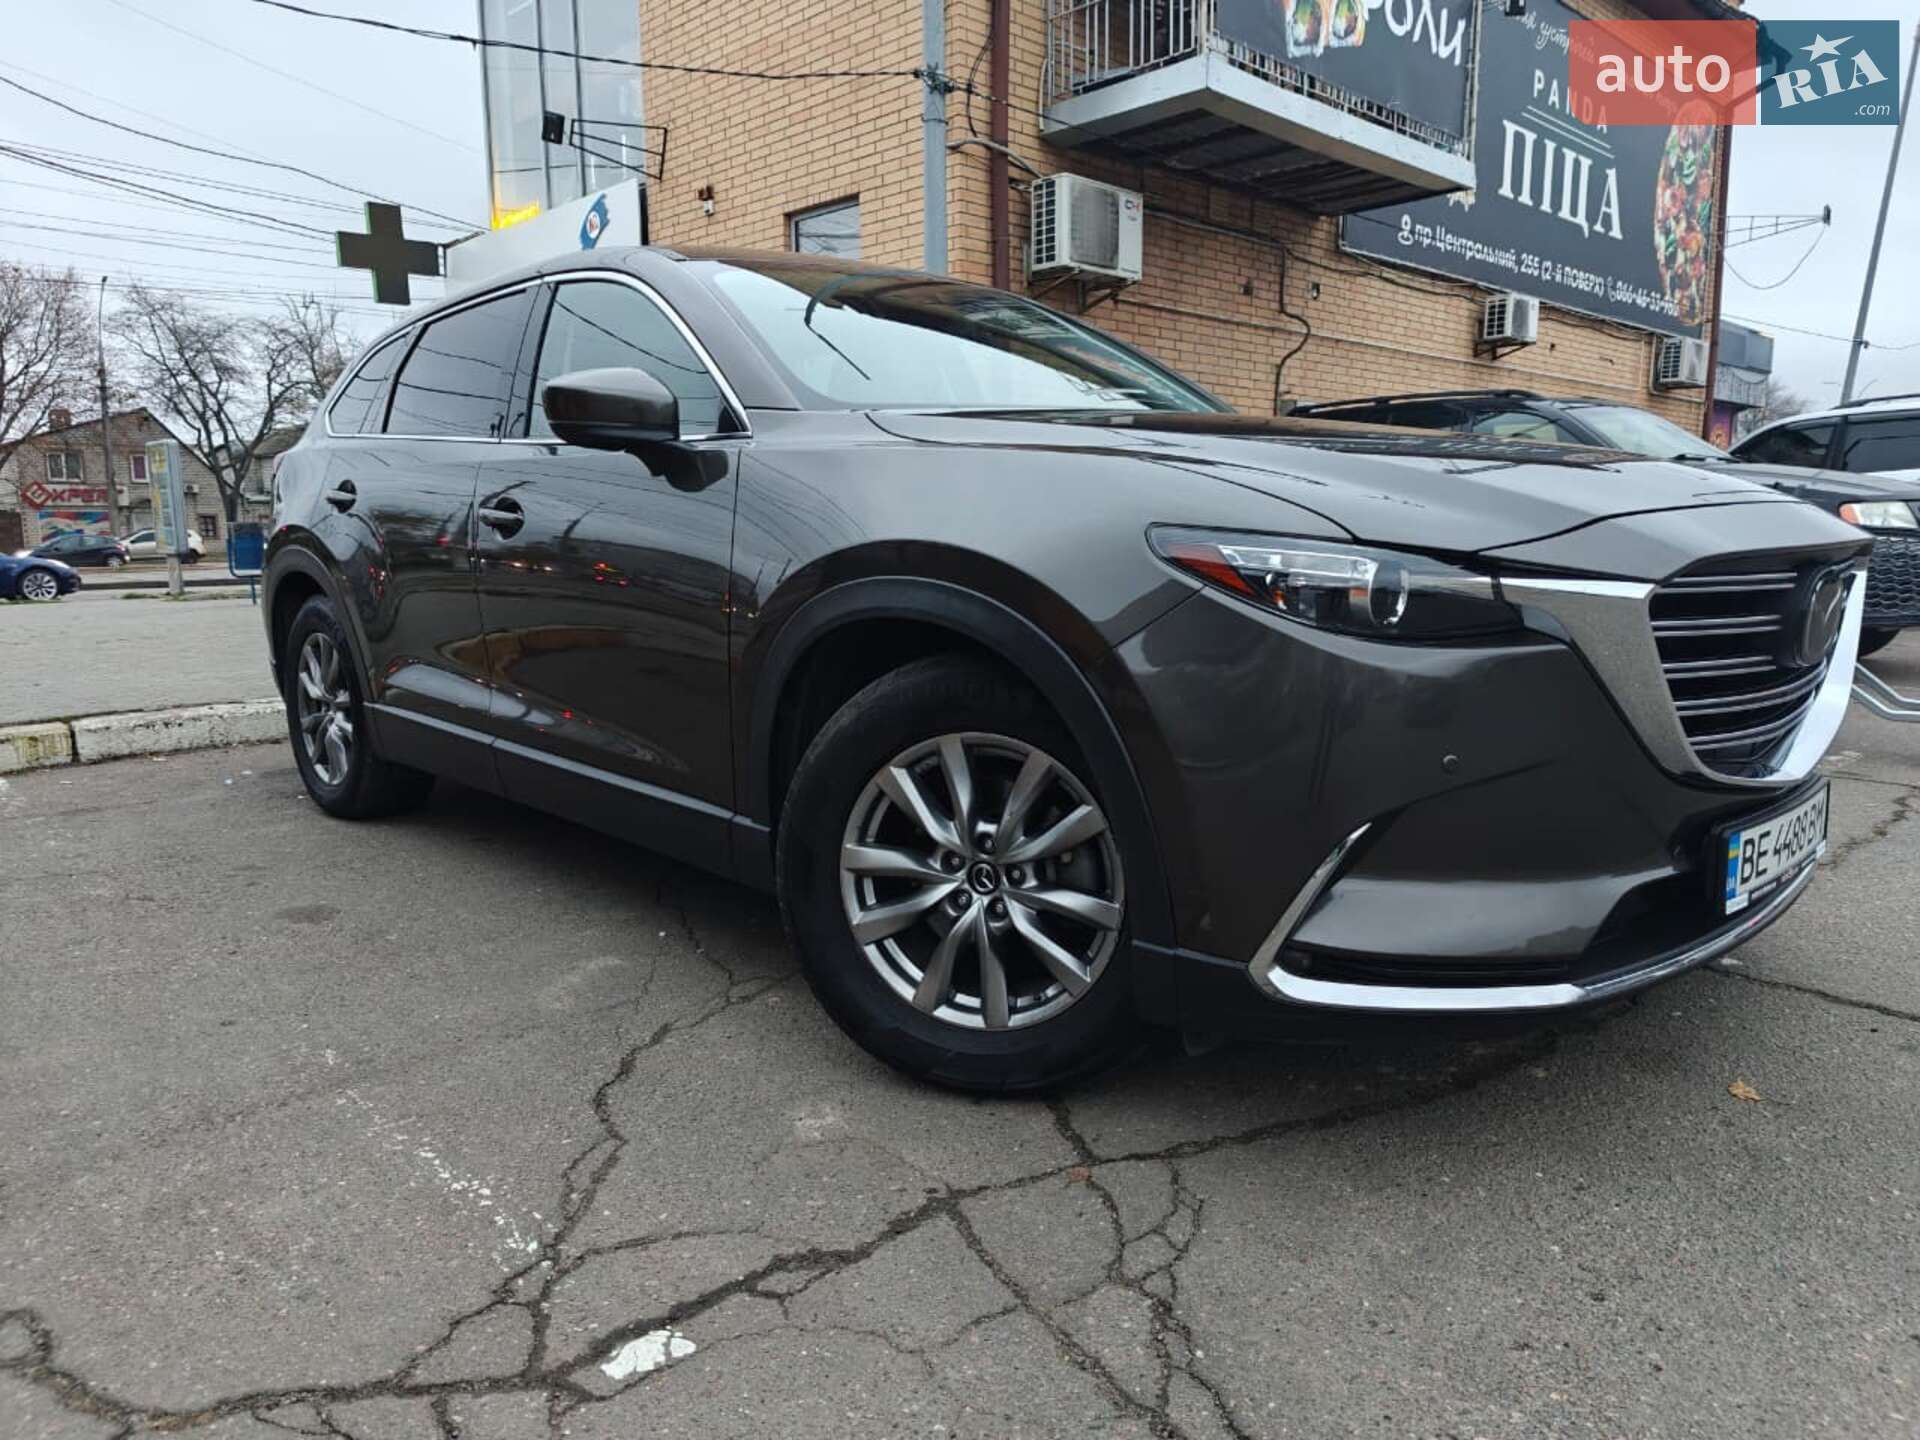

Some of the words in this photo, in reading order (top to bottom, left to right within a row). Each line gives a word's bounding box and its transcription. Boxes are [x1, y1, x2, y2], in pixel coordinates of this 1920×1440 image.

[1533, 68, 1608, 134] PANDA
[1498, 119, 1623, 240] ПІЦА
[1521, 252, 1540, 277] 255
[23, 482, 124, 506] EXPER
